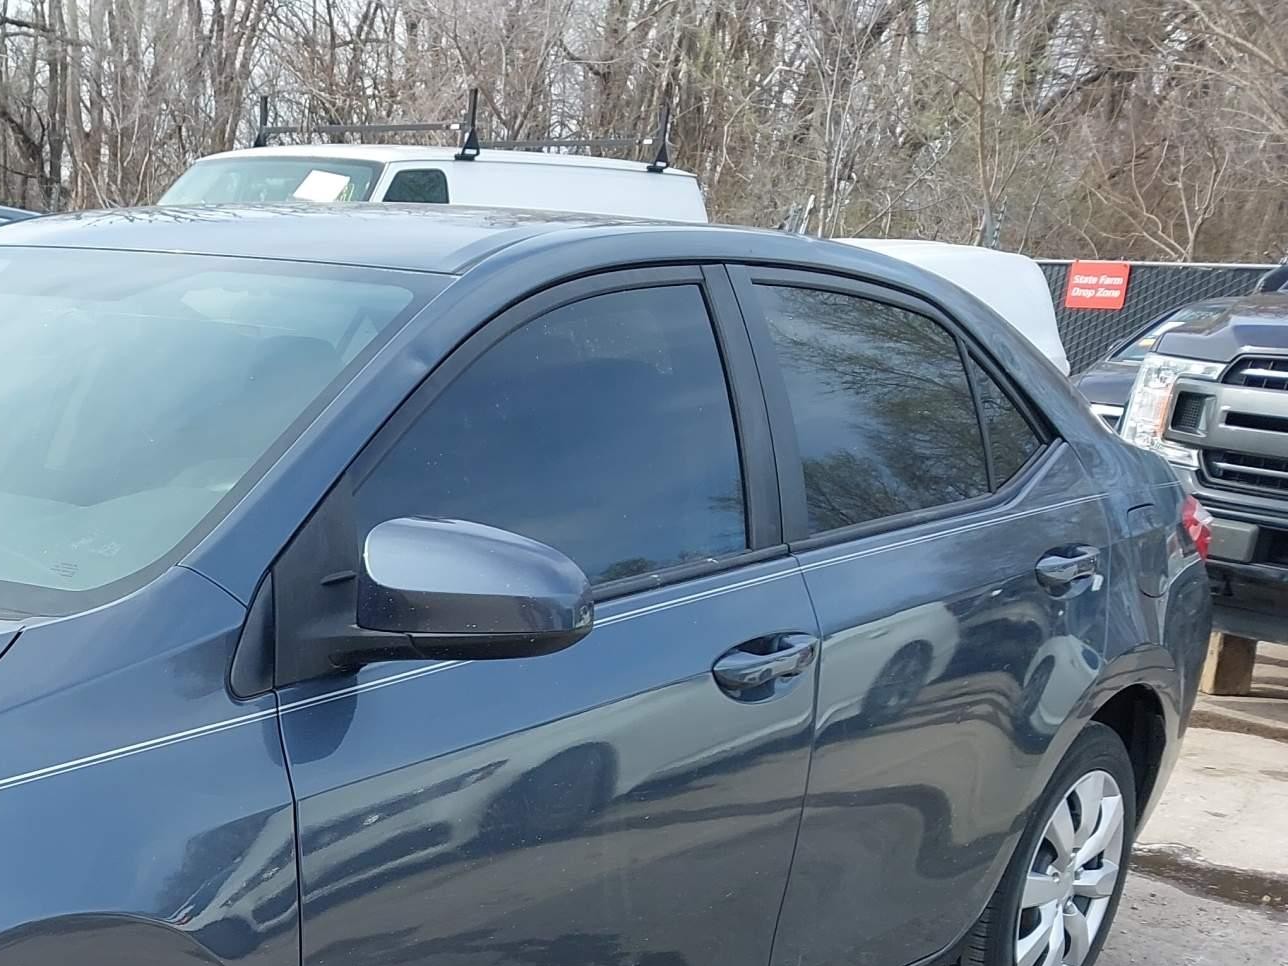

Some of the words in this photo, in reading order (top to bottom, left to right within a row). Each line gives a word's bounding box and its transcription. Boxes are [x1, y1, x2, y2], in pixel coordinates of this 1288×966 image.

[1073, 274, 1098, 285] State
[1099, 275, 1124, 285] Farm
[1071, 287, 1095, 299] Drop
[1095, 288, 1121, 298] Zone
